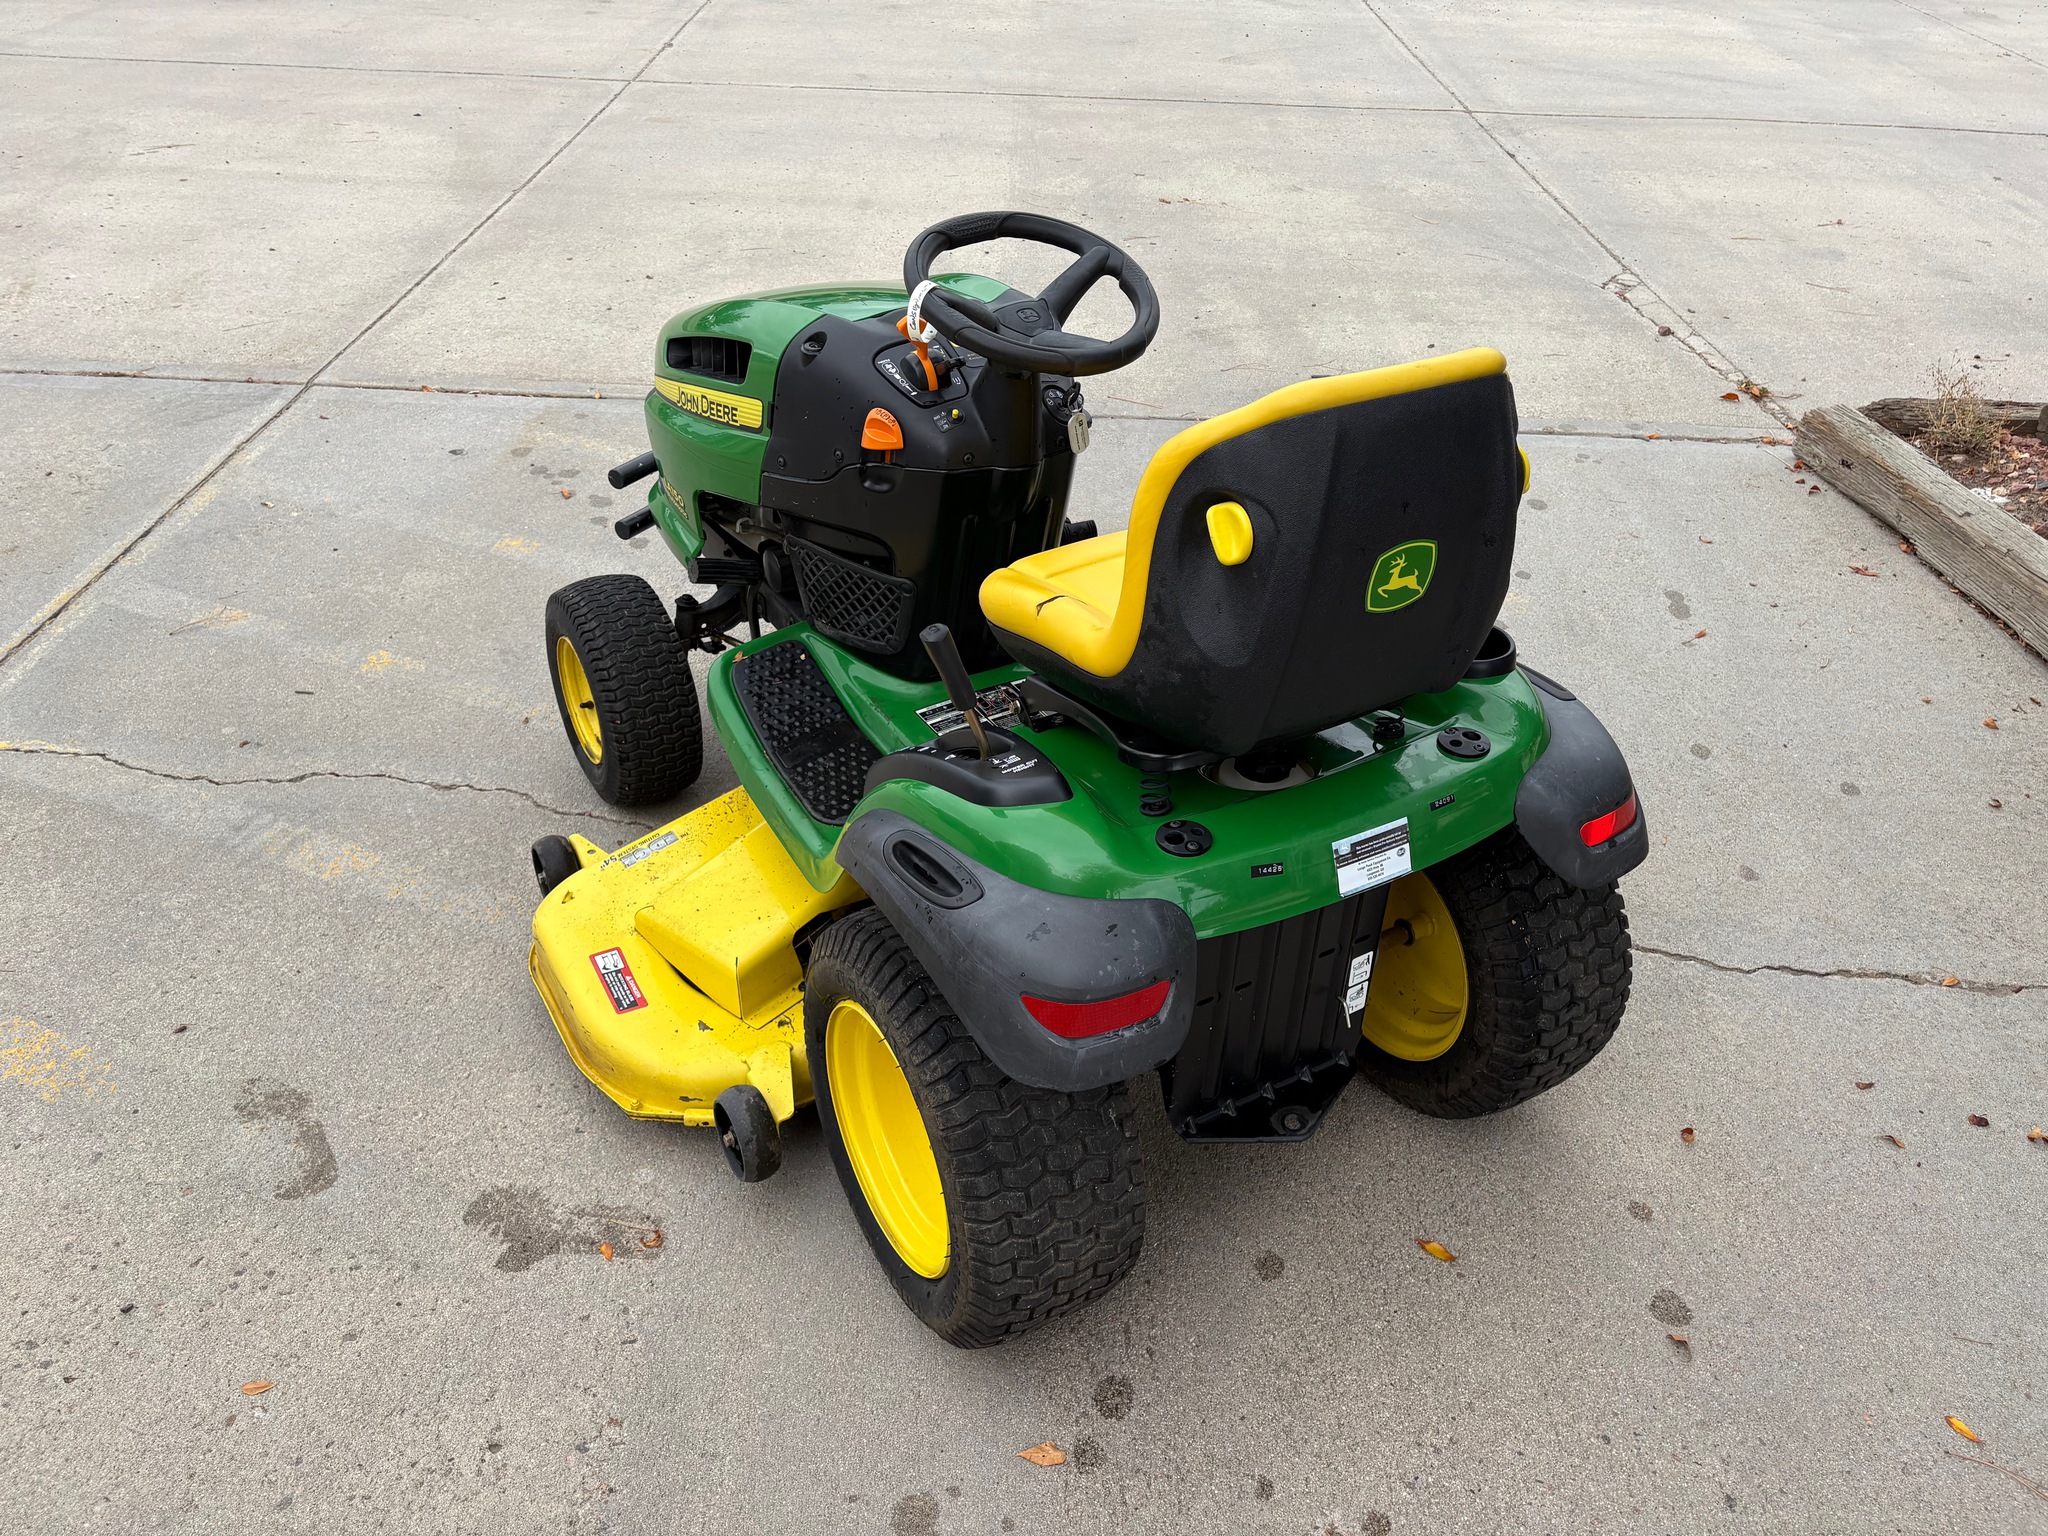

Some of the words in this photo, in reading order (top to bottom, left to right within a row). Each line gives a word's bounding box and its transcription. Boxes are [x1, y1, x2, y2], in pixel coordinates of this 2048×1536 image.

[676, 386, 700, 412] JOHN
[700, 394, 739, 424] DEERE
[628, 979, 642, 999] DANGER
